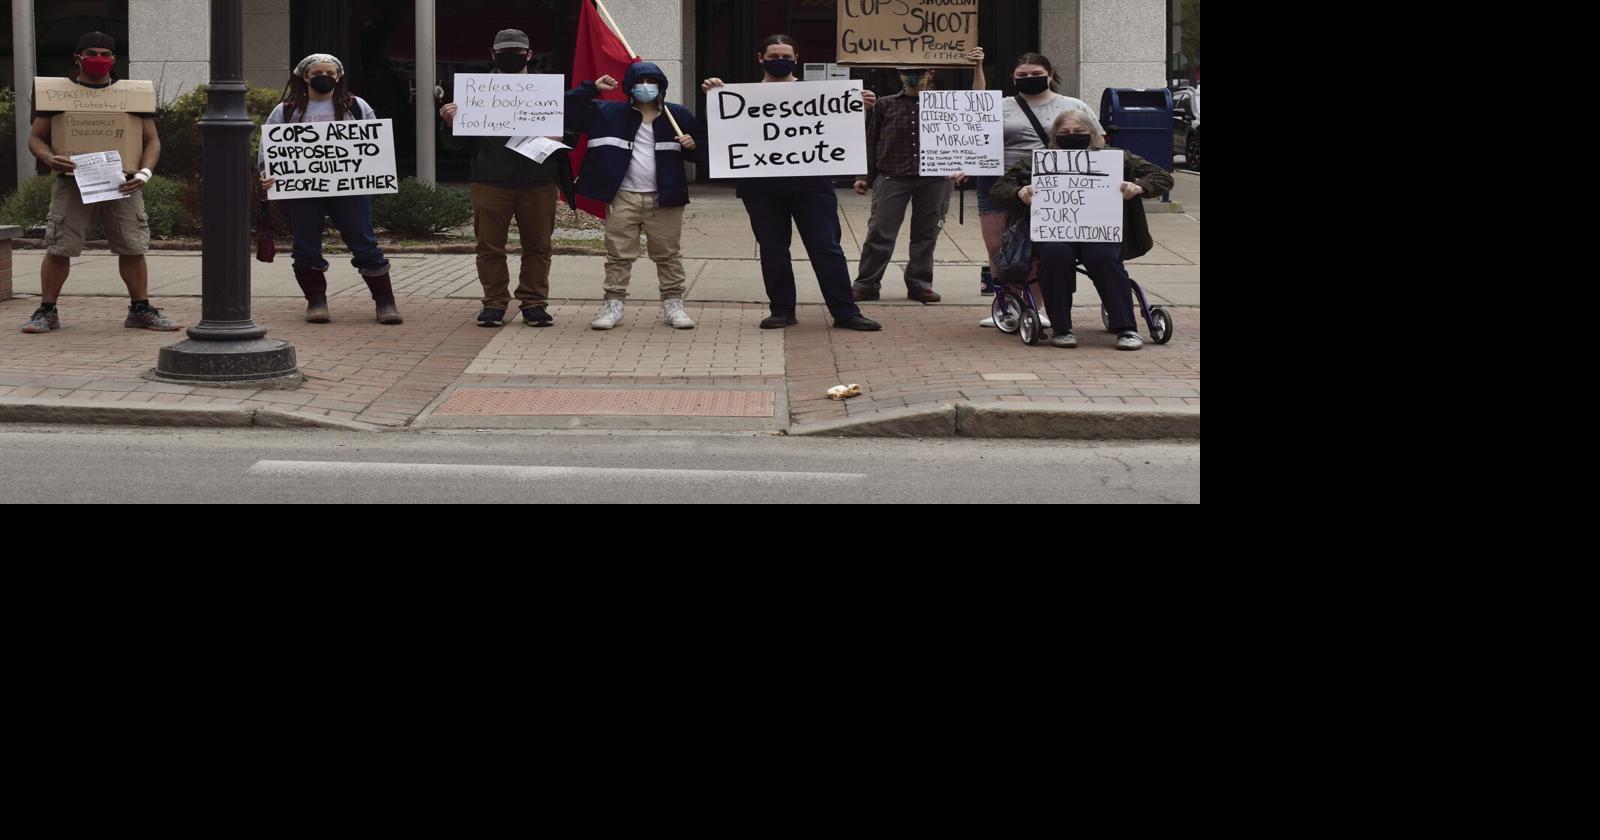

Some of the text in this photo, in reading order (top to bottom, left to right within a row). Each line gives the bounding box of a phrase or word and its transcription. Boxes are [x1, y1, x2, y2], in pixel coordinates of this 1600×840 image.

[903, 7, 977, 35] SHOOT
[842, 29, 966, 54] GUILTY PEOPLE
[923, 52, 968, 60] EITHER
[465, 77, 539, 95] Release
[465, 94, 558, 110] the bodycam
[718, 90, 863, 119] Deescalate
[923, 92, 994, 112] POLICE SEND
[458, 111, 516, 130] footage!
[921, 110, 1000, 122] CITIZENS TO JAIL
[268, 122, 383, 143] COPS ARENT
[922, 123, 984, 133] NOT TO THE
[936, 134, 990, 146] MORGUE!
[267, 143, 380, 159] SUPPOSED TO
[728, 141, 846, 169] Execute
[269, 159, 362, 176] KILL GUILTY
[1034, 151, 1102, 174] POLICE
[275, 174, 397, 192] PEOPLE EITHER
[1035, 176, 1058, 187] ARE
[1041, 189, 1086, 205] JUDGE
[1040, 207, 1080, 224] JURY
[1039, 226, 1120, 241] EXECUTIONER
